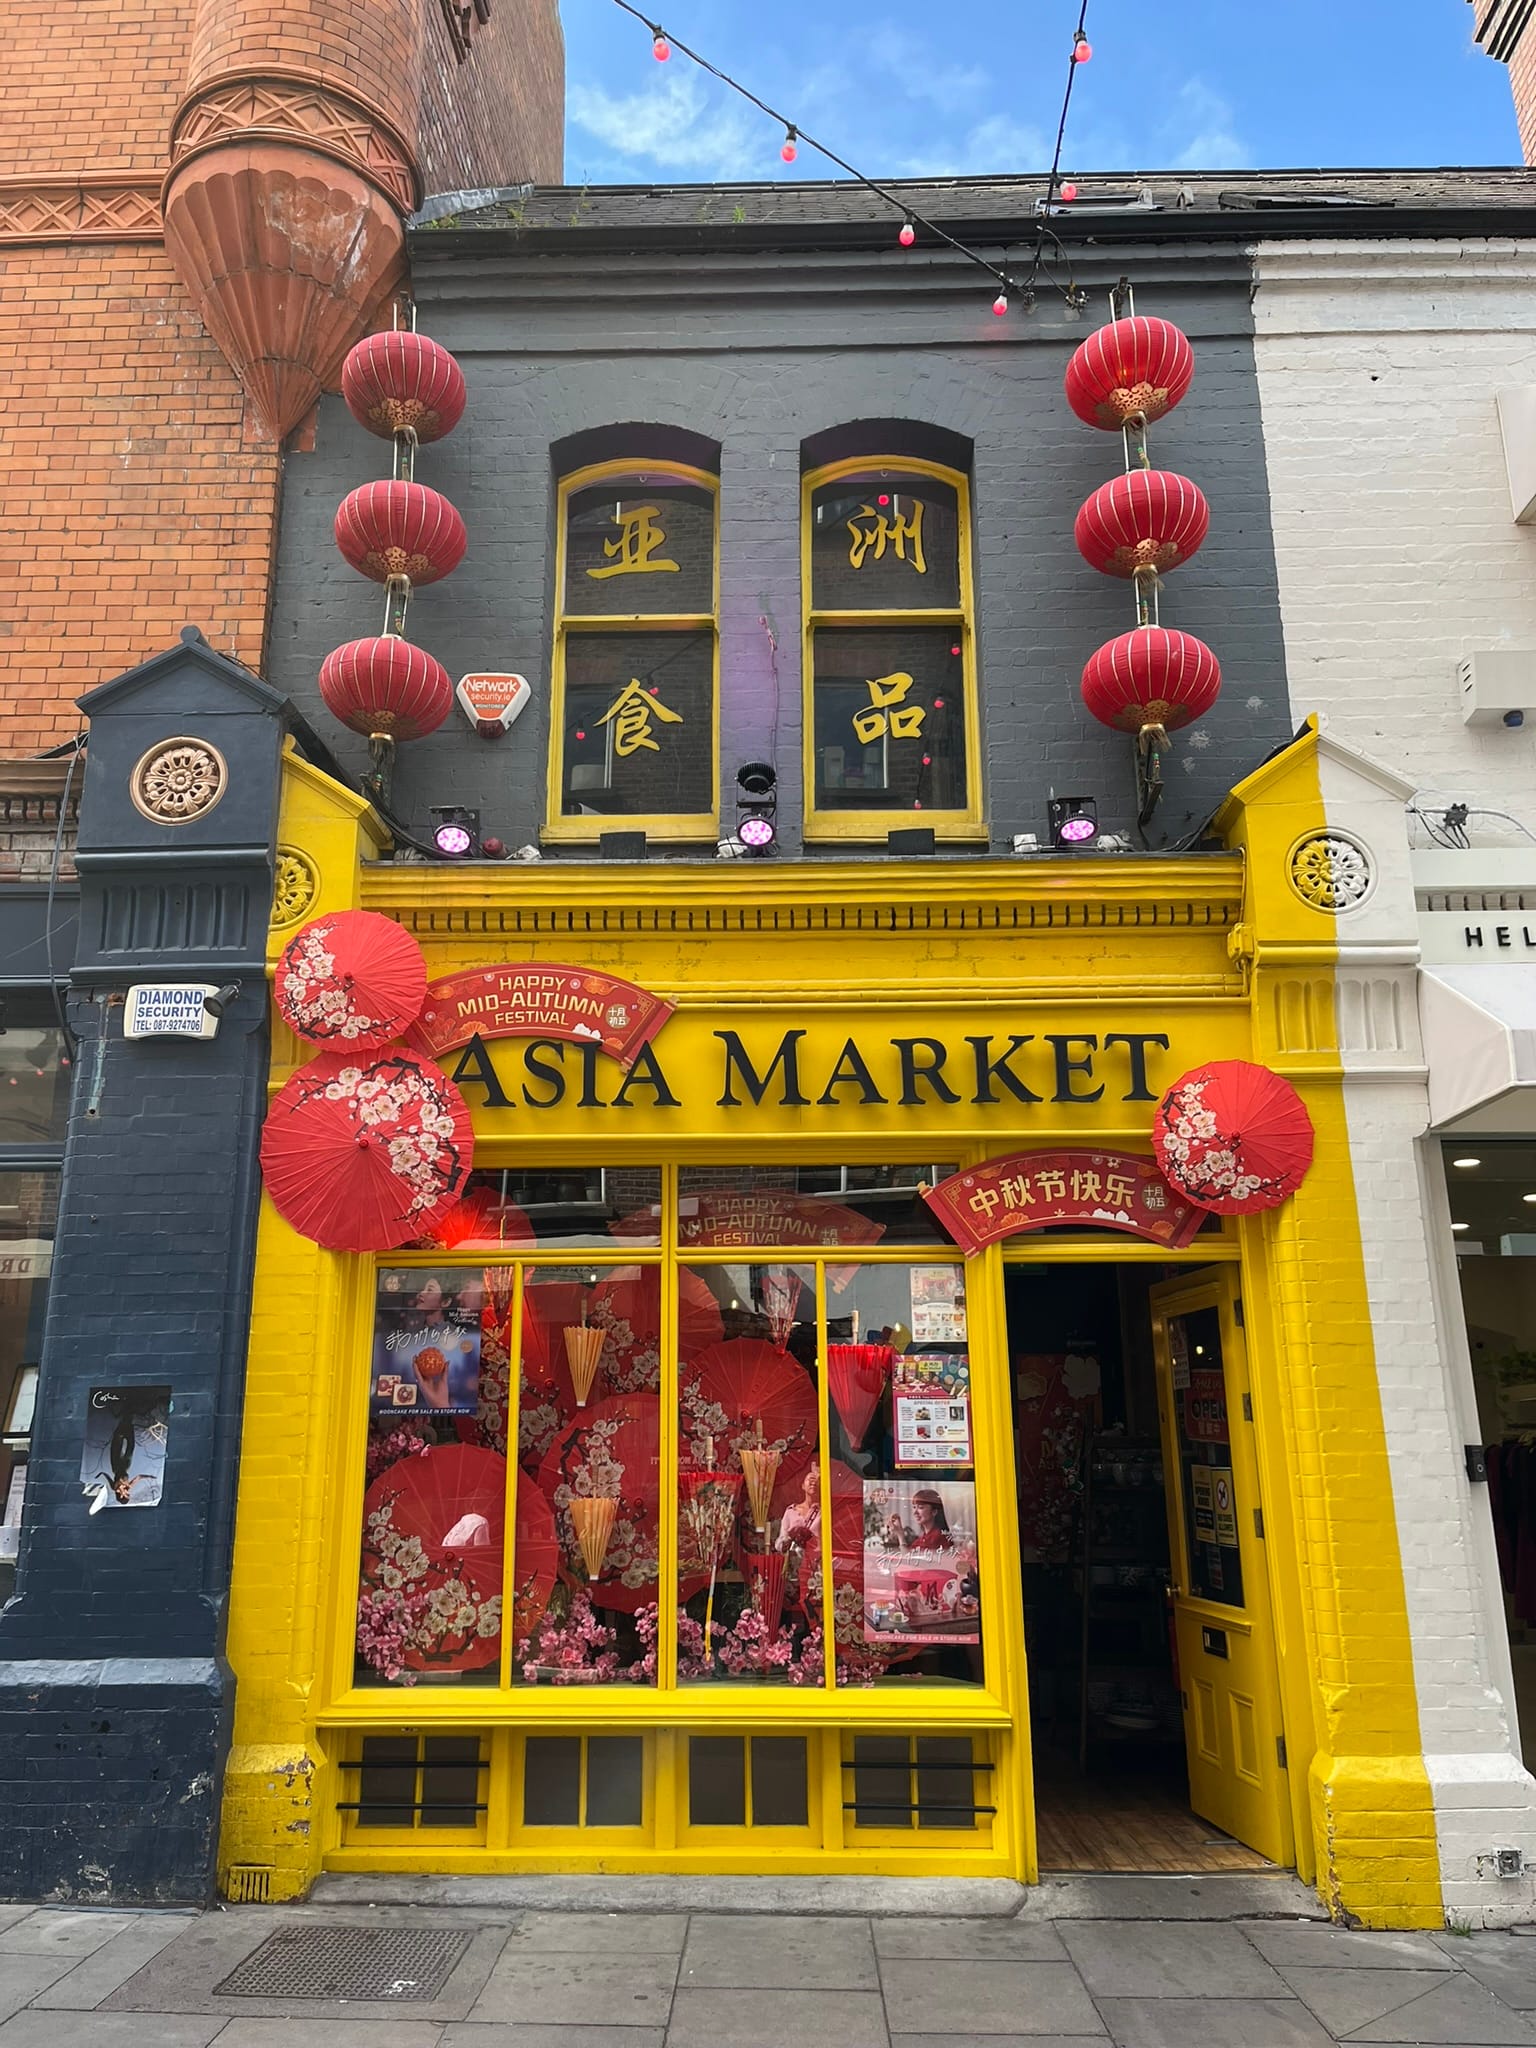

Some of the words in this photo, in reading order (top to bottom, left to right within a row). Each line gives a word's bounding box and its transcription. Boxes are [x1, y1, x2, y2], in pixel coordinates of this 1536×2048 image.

[585, 506, 681, 579] 亚
[847, 499, 927, 574] 洲
[466, 680, 517, 692] Network
[593, 678, 684, 757] 食
[852, 672, 926, 744] 品
[499, 975, 567, 991] HAPPY
[139, 991, 203, 1005] DIAMOND
[456, 991, 604, 1018] MID-AUTUMN
[137, 1006, 201, 1018] SECURITY
[494, 1010, 569, 1026] FESTIVAL
[136, 1020, 152, 1031] TEL:
[153, 1020, 201, 1031] 087-9274706
[450, 1032, 682, 1108] ASIA
[712, 1029, 1171, 1106] MARKET
[968, 1169, 1137, 1218] 中秋节快乐
[717, 1198, 780, 1213] HAPPY
